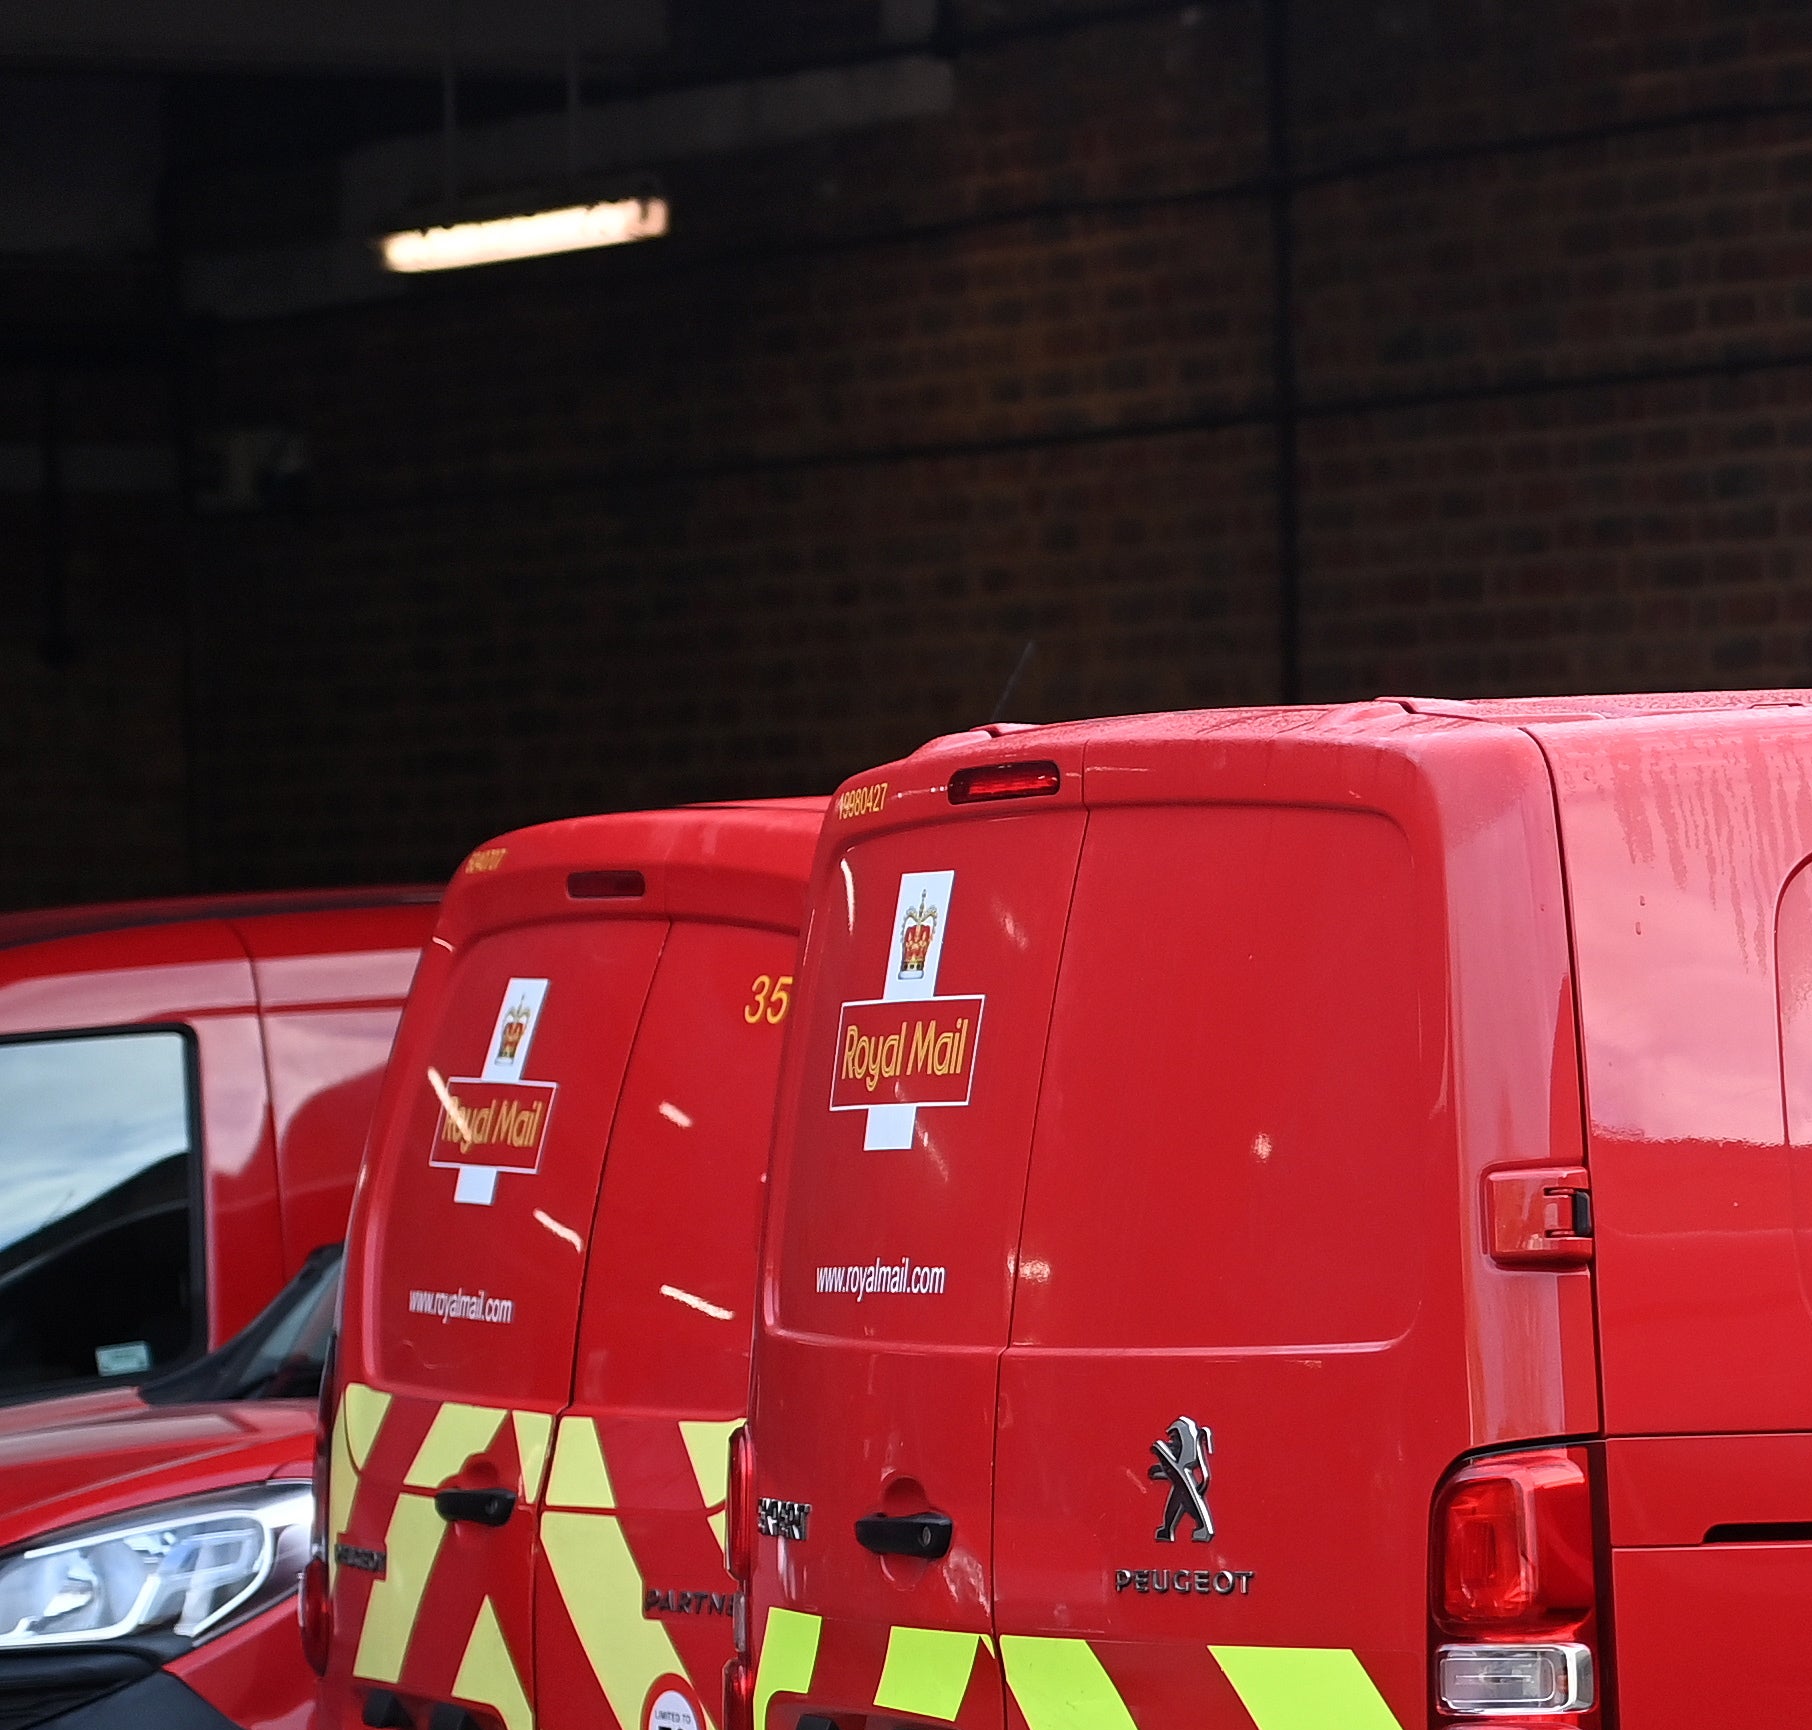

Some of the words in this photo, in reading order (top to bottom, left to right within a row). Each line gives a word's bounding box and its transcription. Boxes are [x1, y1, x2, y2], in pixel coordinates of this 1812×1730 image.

[744, 974, 793, 1024] 35
[842, 1022, 907, 1091] Royal
[906, 1018, 969, 1076] Mail
[441, 1096, 496, 1154] Royal
[491, 1099, 543, 1148] Mail
[816, 1257, 947, 1302] www.royalmail.com
[409, 1287, 513, 1324] www.royalmail.com
[1115, 1568, 1255, 1595] PEUGEOT
